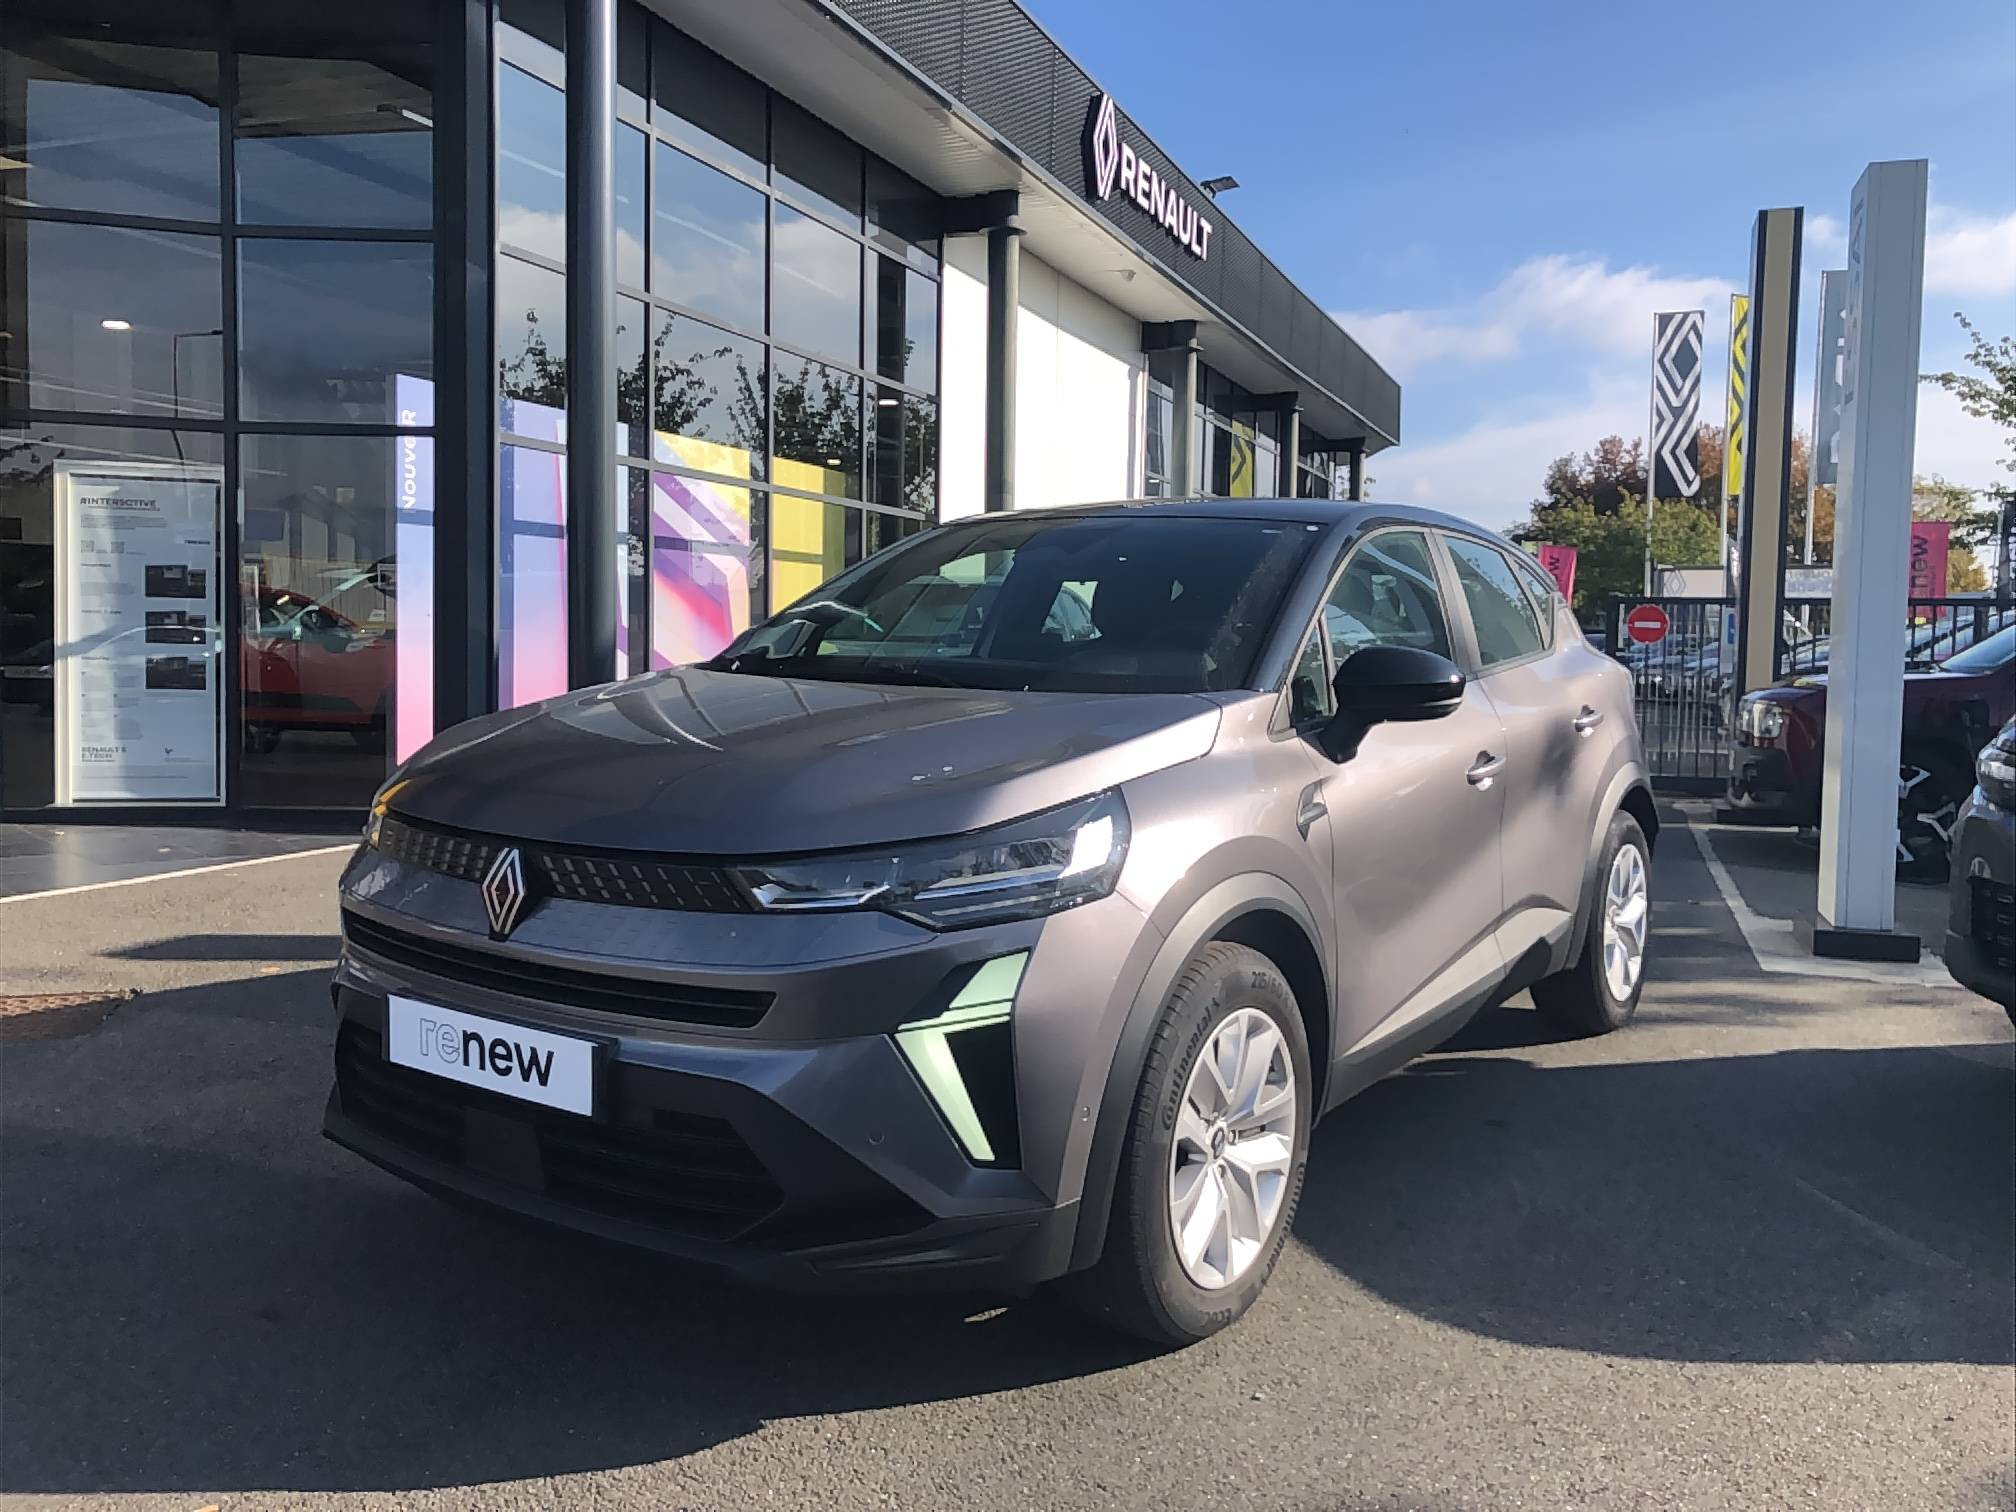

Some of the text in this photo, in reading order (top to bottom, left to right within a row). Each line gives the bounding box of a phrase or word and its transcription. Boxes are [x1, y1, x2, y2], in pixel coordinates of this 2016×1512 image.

[1121, 142, 1213, 262] RENAULT
[420, 1018, 554, 1087] renew
[1162, 1005, 1213, 1131] Continental
